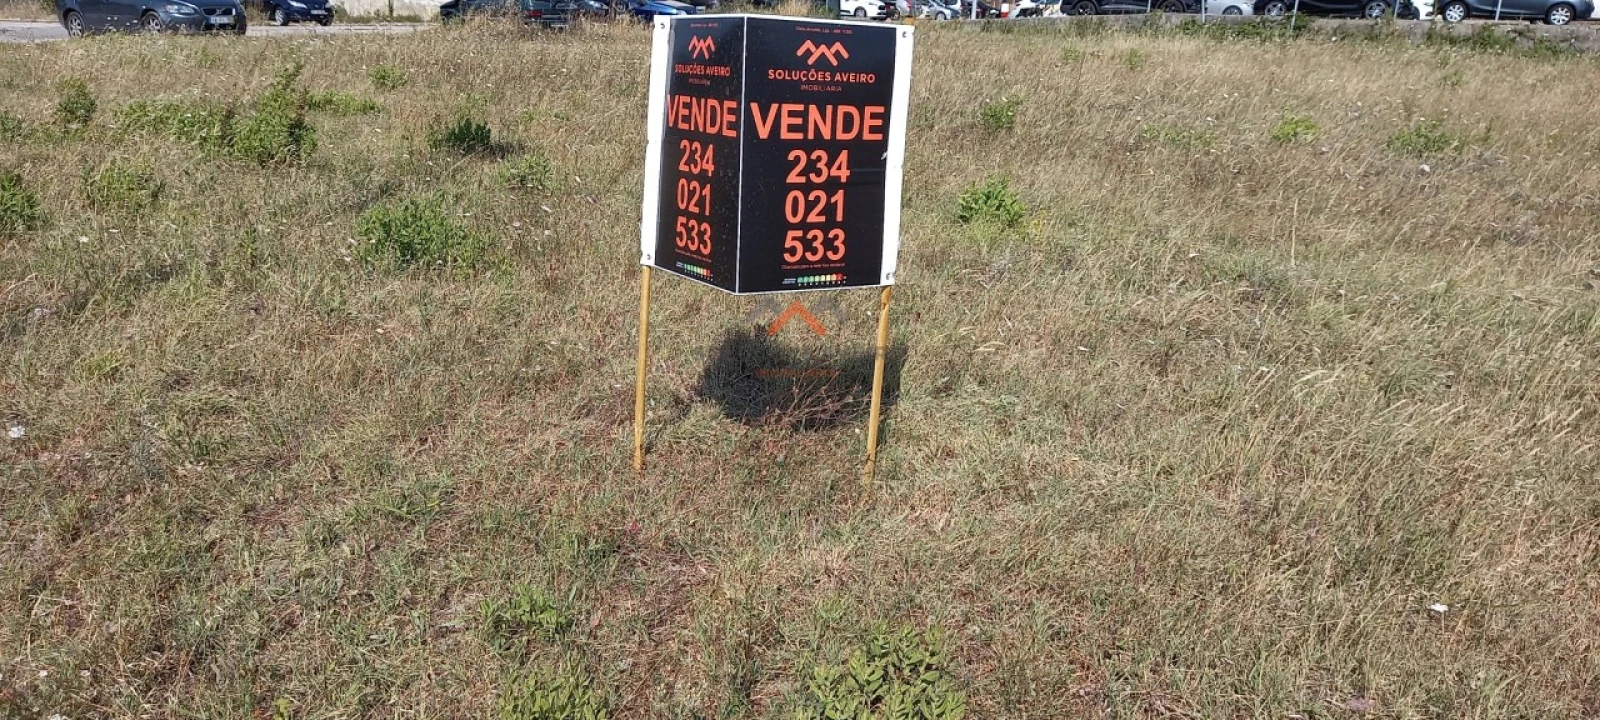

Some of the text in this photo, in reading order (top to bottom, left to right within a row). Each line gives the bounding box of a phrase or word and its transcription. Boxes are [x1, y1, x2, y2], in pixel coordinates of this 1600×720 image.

[674, 63, 731, 77] SOLUÇÕES AVEIRO
[768, 68, 876, 84] SOLUÇÕES AVEIRO
[667, 94, 738, 137] VENDE
[750, 102, 885, 140] VENDE
[678, 139, 714, 177] 234
[786, 149, 851, 184] 234
[677, 178, 711, 216] 021
[784, 189, 845, 224] 021
[675, 215, 712, 256] 533
[783, 228, 846, 262] 533
